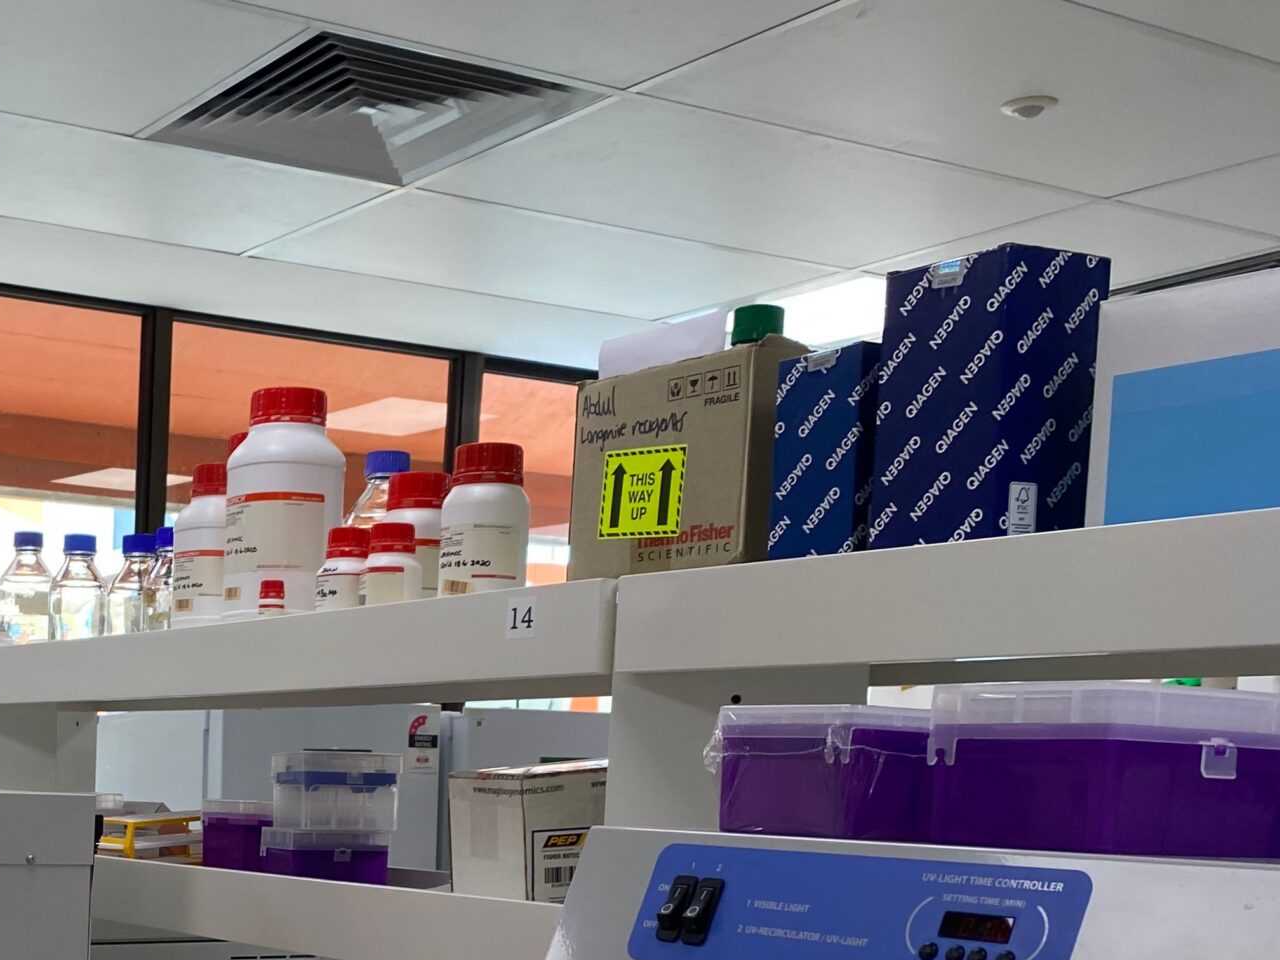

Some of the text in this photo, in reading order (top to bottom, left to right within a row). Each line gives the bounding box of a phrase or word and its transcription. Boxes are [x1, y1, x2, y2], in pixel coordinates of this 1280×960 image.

[986, 260, 1029, 312] QIAGEN
[1038, 251, 1072, 289] IAGEN
[929, 295, 971, 350] QIAGEN
[1016, 307, 1054, 354] QIAGEN
[1064, 288, 1099, 334] QIAGEN
[959, 329, 1004, 385] QIAGEN
[1043, 352, 1079, 399] QIAGEN
[582, 386, 616, 417] Abdul
[704, 393, 740, 407] FRAGILE
[798, 389, 836, 438] QIAGEN
[905, 366, 947, 418] QIAGEN
[991, 373, 1031, 421] QIAGEN
[825, 421, 864, 471] QIAGEN
[935, 401, 978, 454] QIAGEN
[1020, 418, 1056, 465] QIAGEN
[629, 471, 656, 486] THIS
[775, 453, 813, 501] QIAGEN
[881, 436, 921, 486] QIAGEN
[966, 439, 1010, 491] QIAGEN
[628, 489, 654, 503] WAY
[910, 471, 952, 523] QIAGEN
[1046, 462, 1082, 509] QIAGEN
[631, 506, 647, 520] UP
[802, 486, 841, 534] QIAGEN
[637, 542, 732, 563] SCIENTIFIC
[510, 606, 534, 630] 14
[547, 835, 577, 846] PEP
[754, 900, 783, 911] VISIBLE
[784, 903, 810, 913] LIGHT
[922, 873, 1064, 893] UV-LIGHT TIME CONTROLLER
[942, 893, 978, 904] SETTING
[979, 897, 1000, 906] TIME
[643, 919, 658, 929] OFF
[825, 934, 868, 948] UV-LIGHT
